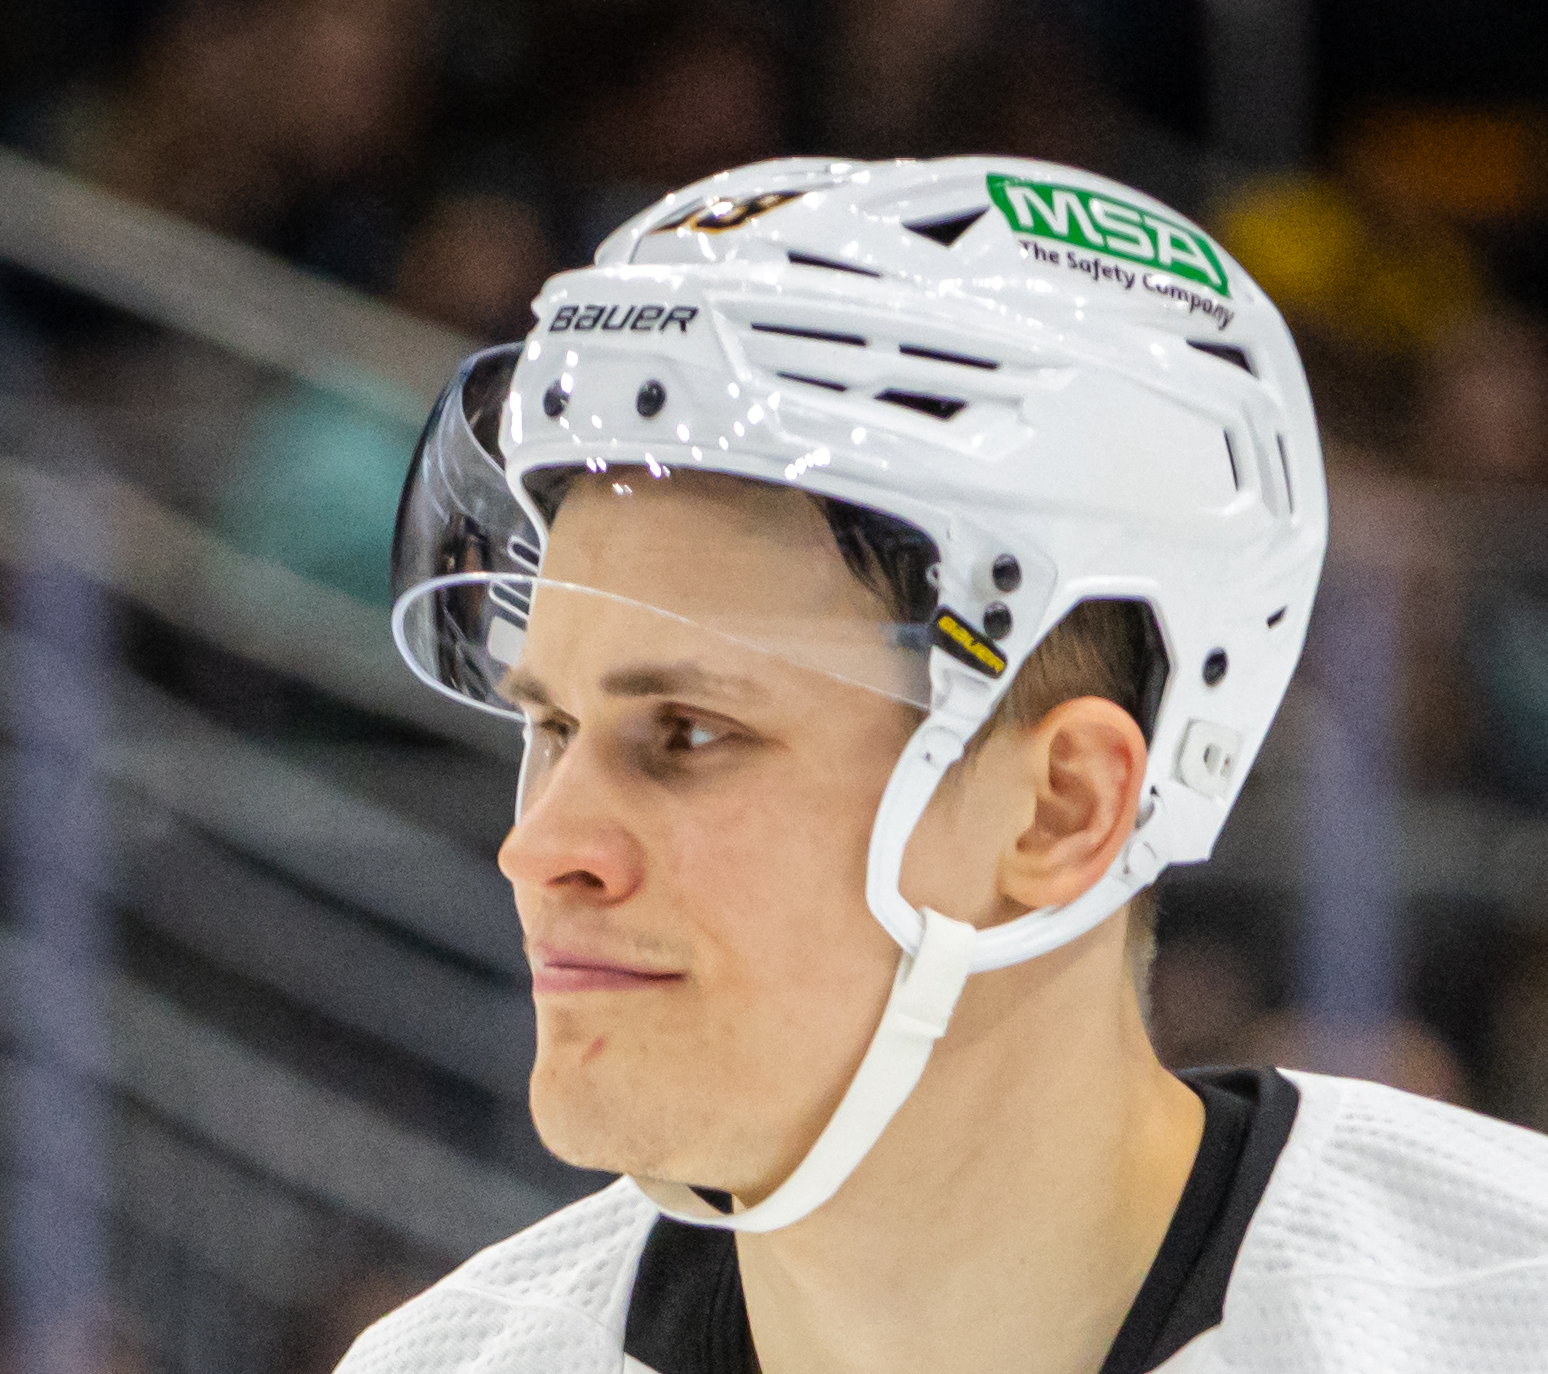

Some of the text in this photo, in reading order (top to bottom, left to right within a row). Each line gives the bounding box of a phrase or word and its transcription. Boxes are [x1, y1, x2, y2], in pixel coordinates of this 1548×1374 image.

[1004, 184, 1224, 287] MSA
[1020, 239, 1235, 331] The Safety Company
